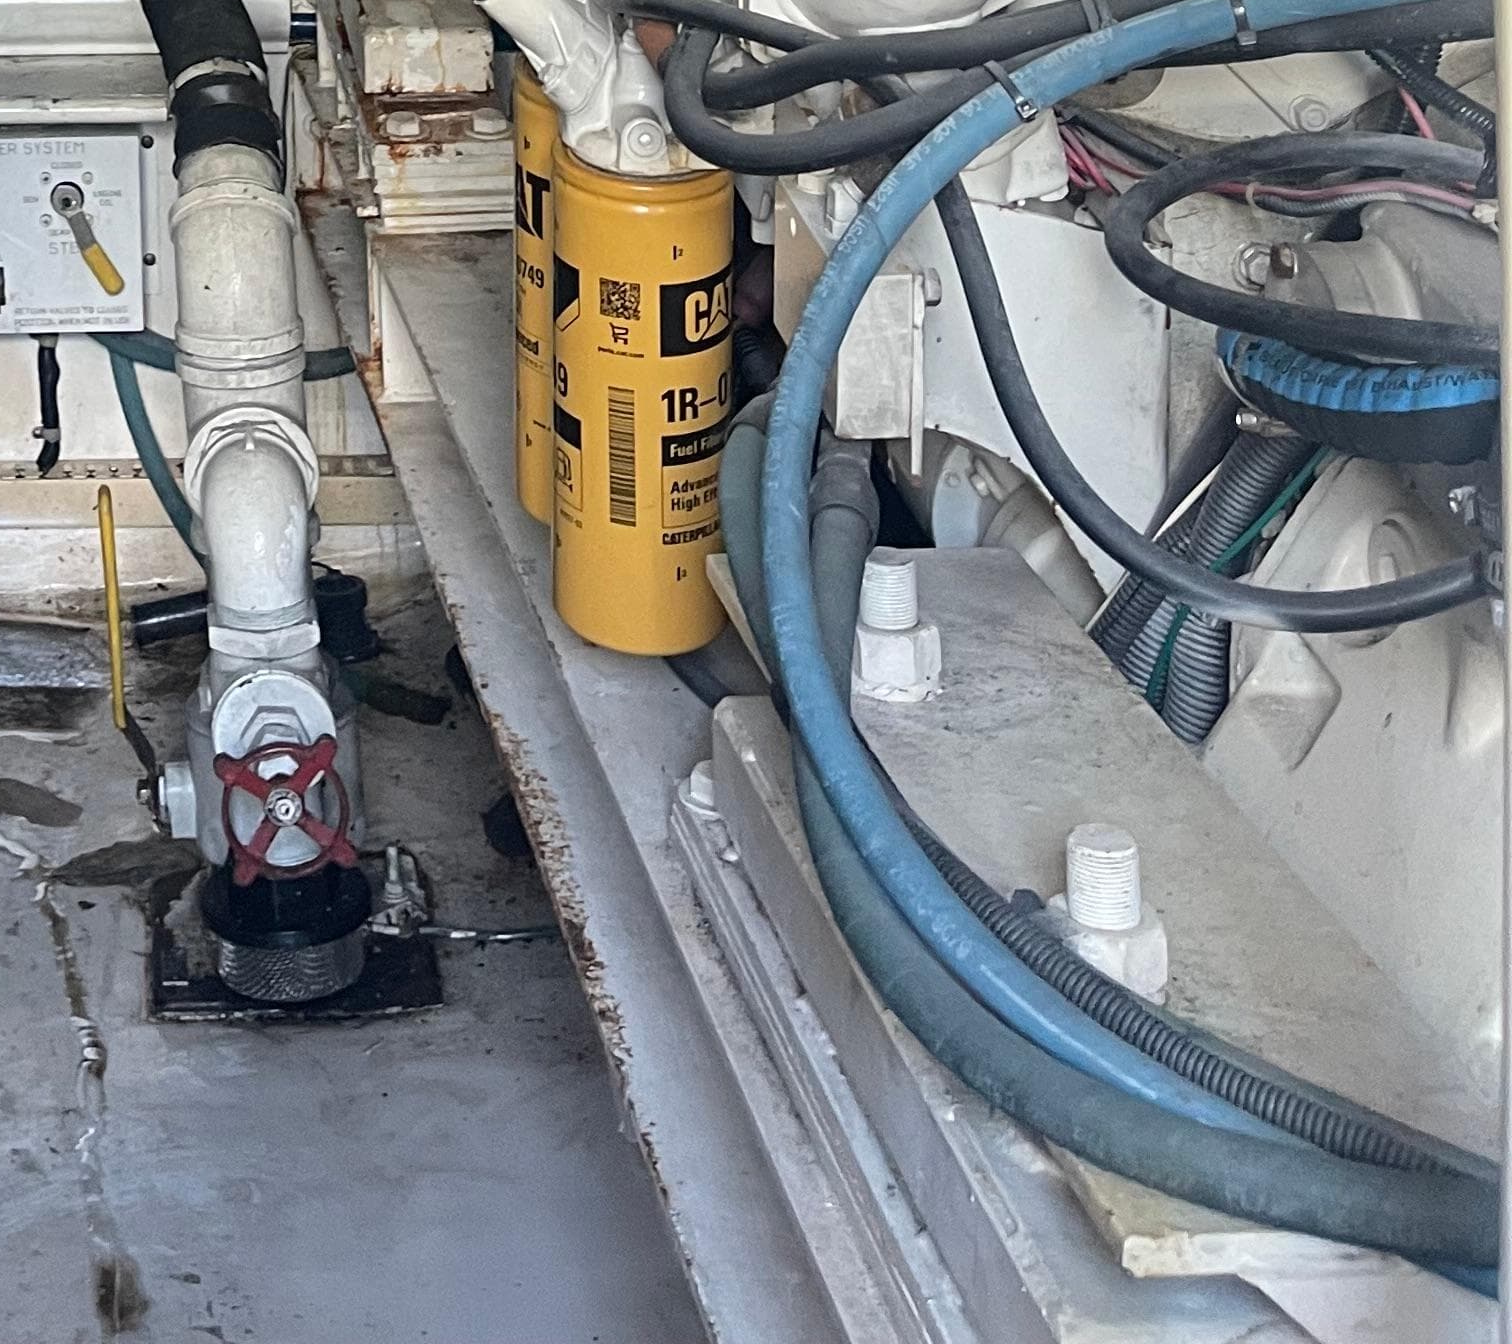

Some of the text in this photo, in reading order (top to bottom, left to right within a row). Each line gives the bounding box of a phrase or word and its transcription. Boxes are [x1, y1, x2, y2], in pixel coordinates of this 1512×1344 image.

[23, 141, 85, 155] SYSTEM
[516, 161, 550, 240] AT
[661, 372, 727, 423] 1R-0
[670, 439, 698, 459] Fuel
[671, 492, 701, 512] High
